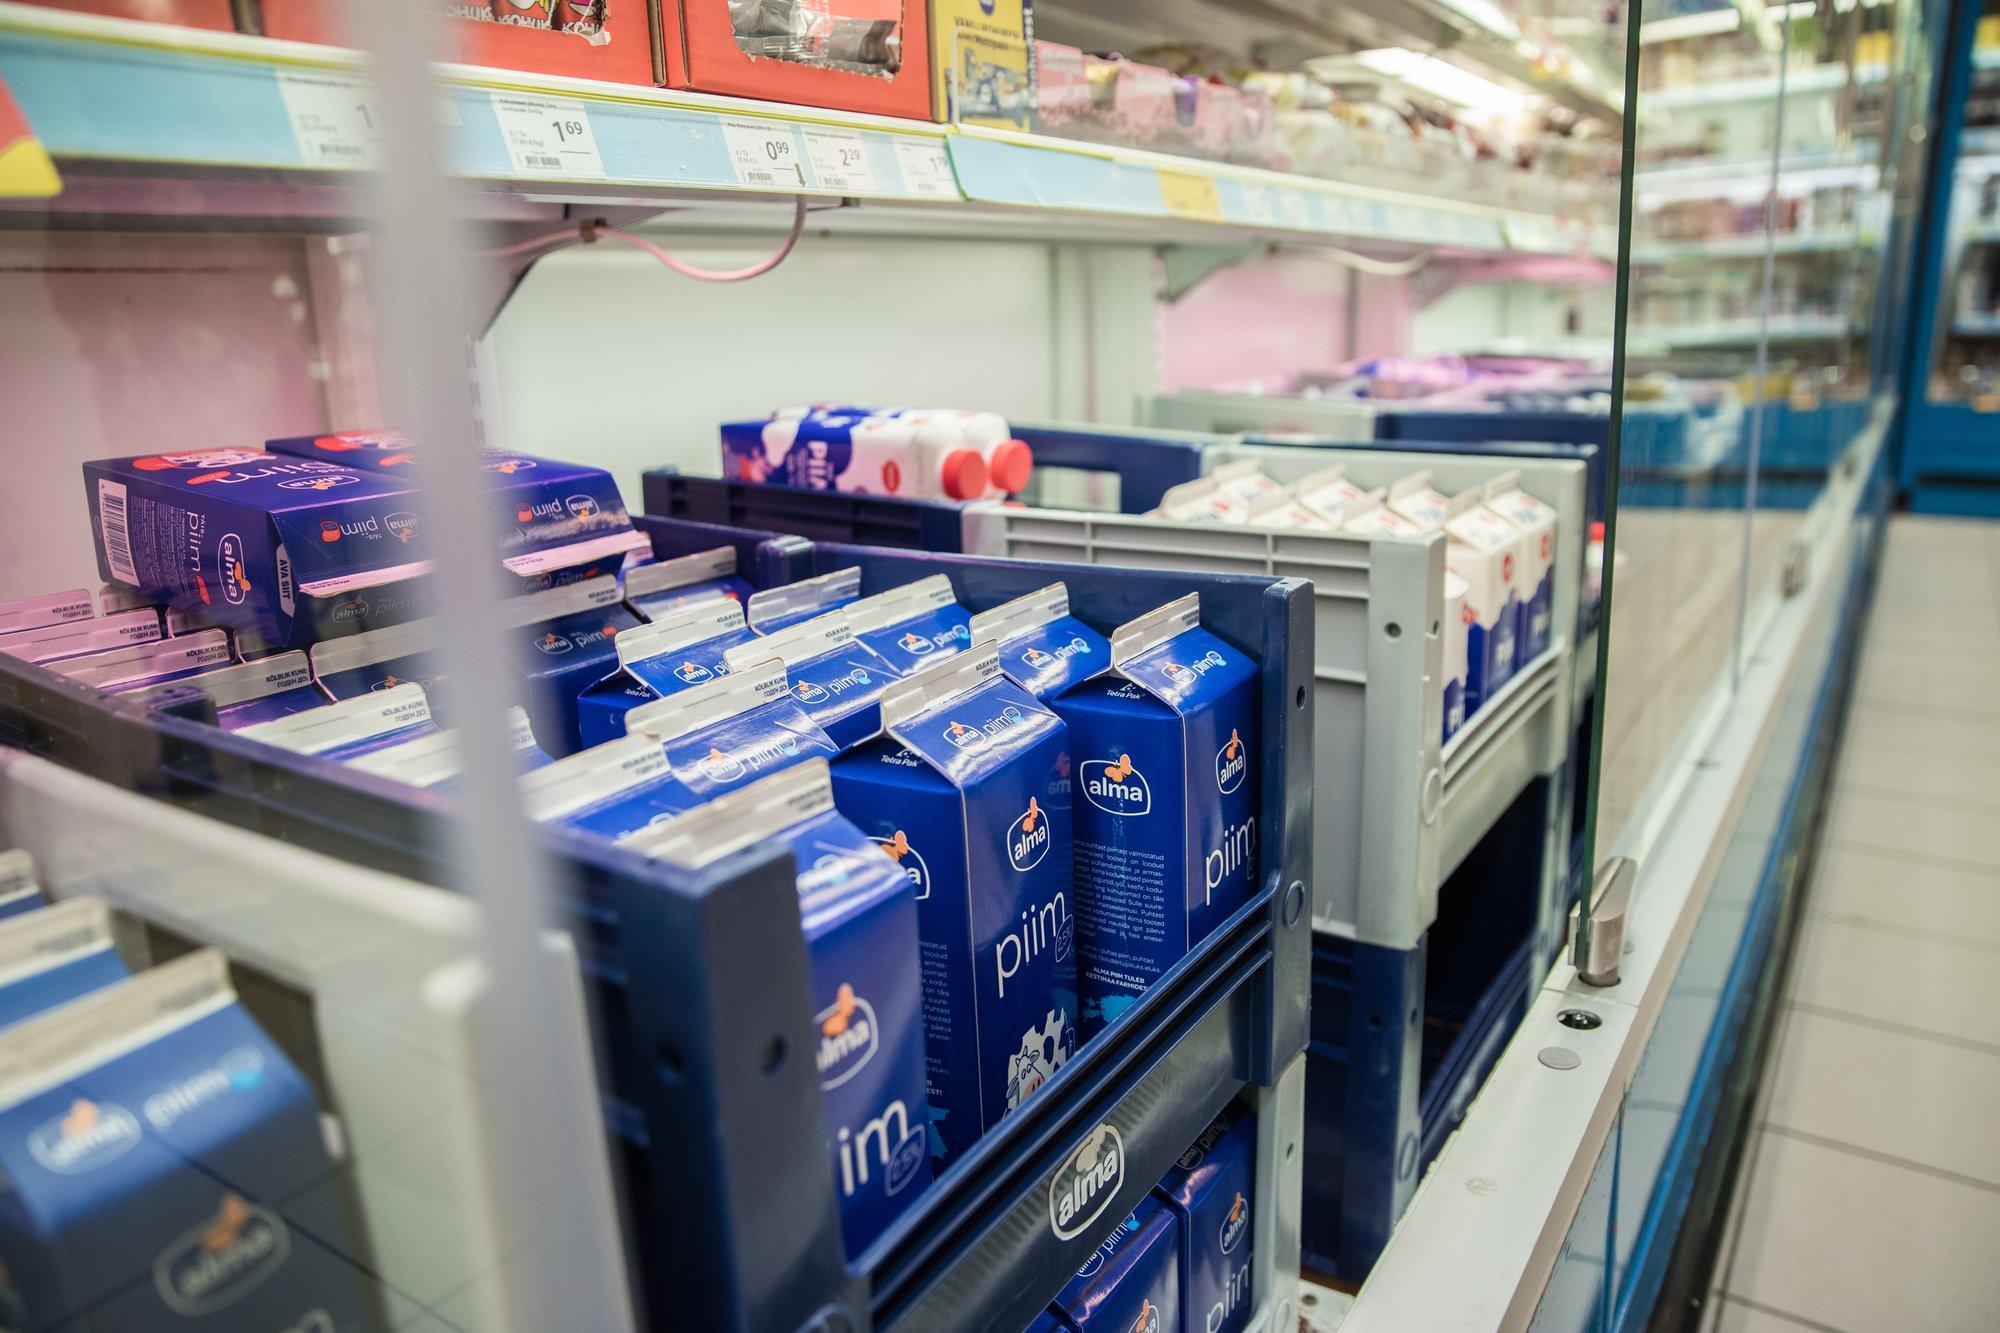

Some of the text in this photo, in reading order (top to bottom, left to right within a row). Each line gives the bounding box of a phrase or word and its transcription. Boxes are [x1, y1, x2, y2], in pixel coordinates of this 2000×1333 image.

[531, 498, 562, 516] piim
[187, 511, 201, 572] piim
[340, 516, 379, 537] piim
[223, 541, 237, 598] alma
[280, 559, 291, 600] AVA SIIT
[683, 660, 729, 681] alma pi
[1193, 659, 1218, 677] piim
[800, 677, 857, 701] alma piim
[1107, 689, 1141, 700] Tetra Pak
[955, 714, 1013, 746] alma piim
[750, 744, 784, 771] piim
[881, 754, 918, 768] Tetra Pak
[1220, 754, 1244, 784] alma
[1089, 777, 1143, 802] alma
[1014, 826, 1046, 861] alma
[1206, 816, 1256, 906] piim
[996, 892, 1066, 998] piim
[1093, 966, 1145, 984] ALMA PIIM TULEB
[837, 1099, 909, 1198] im
[1058, 1149, 1119, 1227] alma
[1102, 1223, 1129, 1255] piim
[1223, 1210, 1247, 1248] alma
